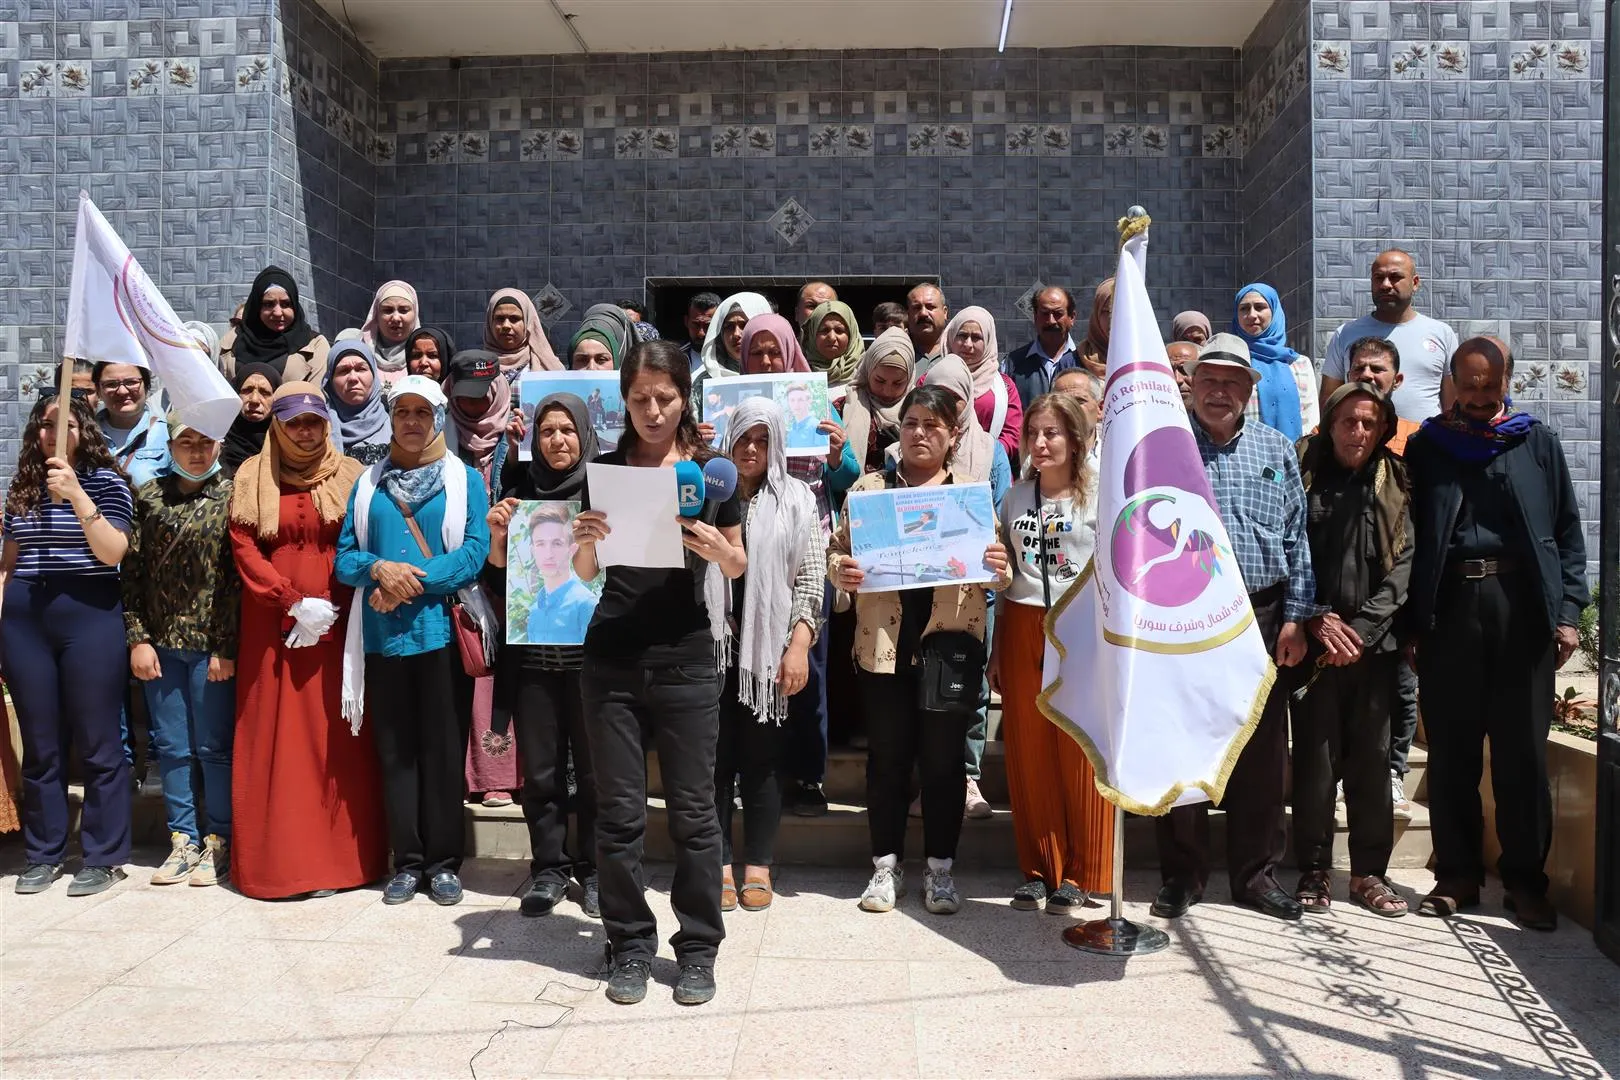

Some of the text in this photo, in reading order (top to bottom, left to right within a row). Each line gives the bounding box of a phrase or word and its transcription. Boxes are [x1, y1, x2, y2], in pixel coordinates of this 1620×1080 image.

[680, 484, 700, 503] R
[1013, 520, 1037, 532] THE
[1023, 535, 1041, 548] OF
[1134, 613, 1166, 632] سوريا
[1206, 605, 1232, 628] شمال
[952, 652, 967, 661] Jeep
[949, 681, 966, 690] Jeep
